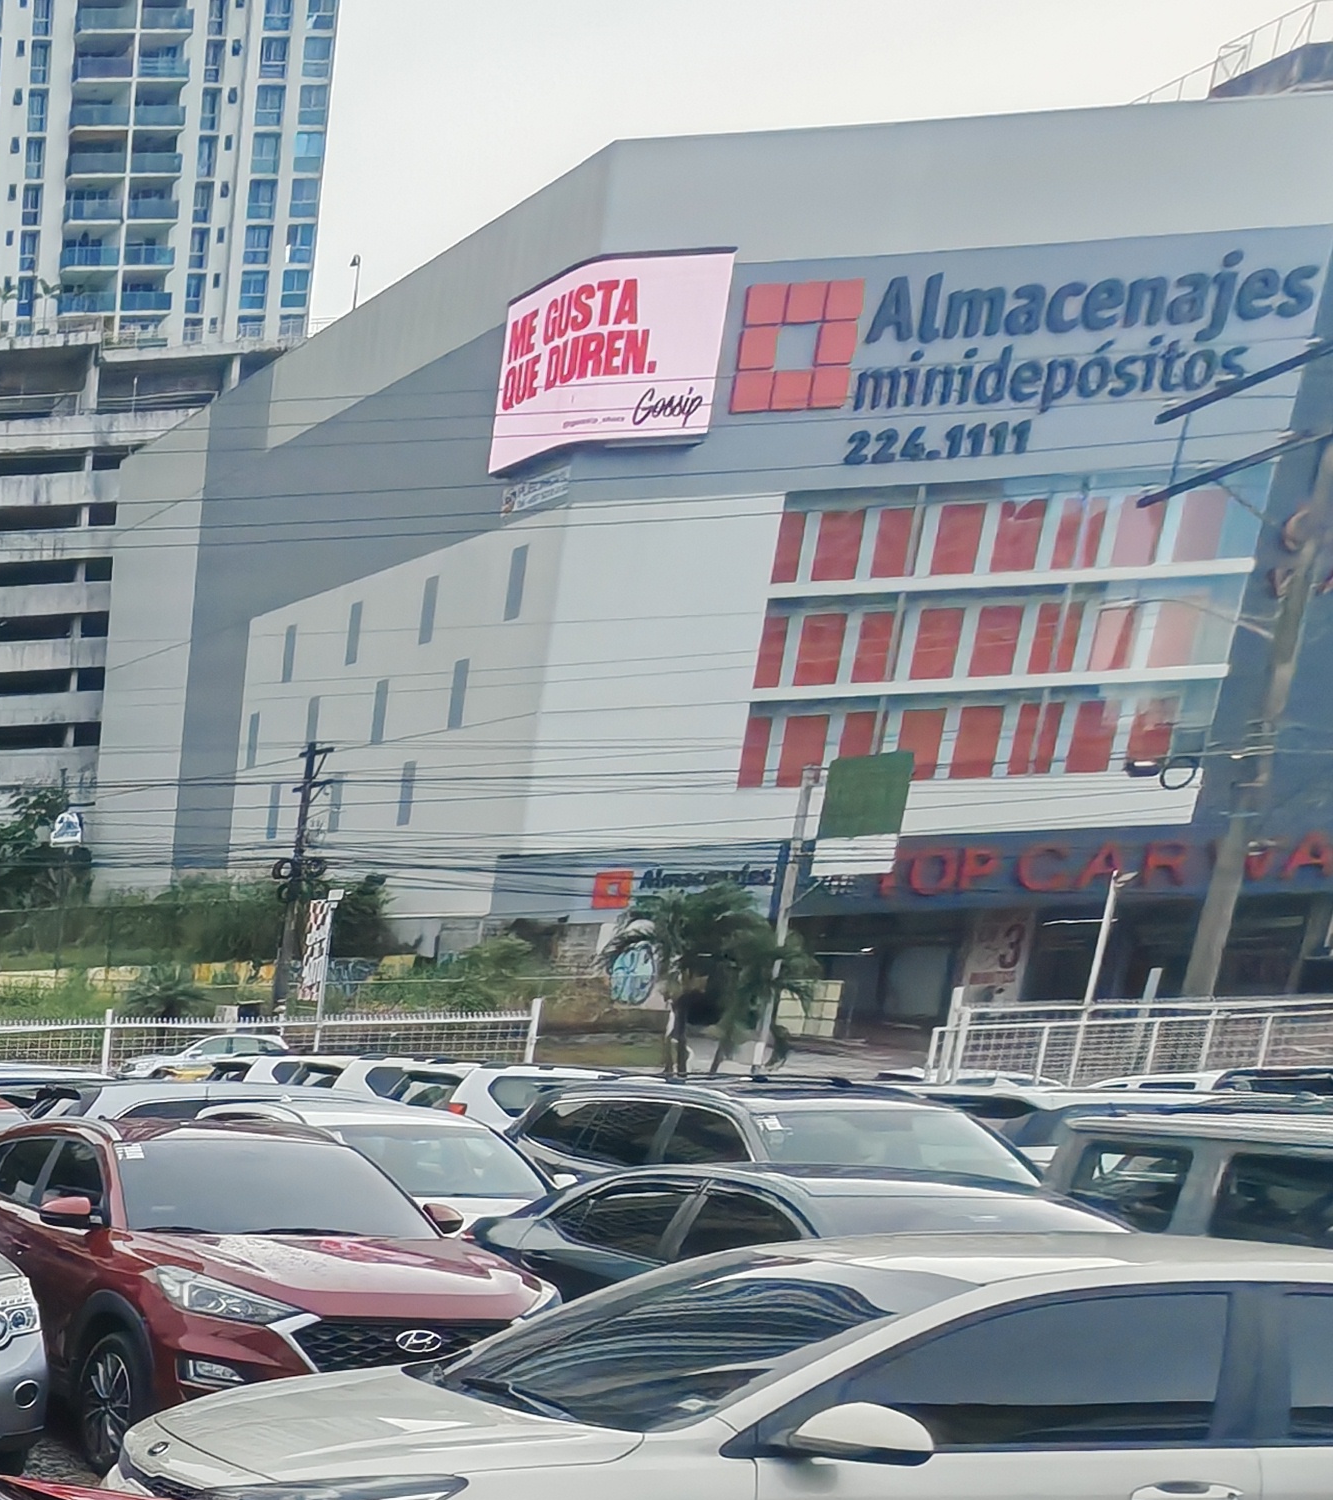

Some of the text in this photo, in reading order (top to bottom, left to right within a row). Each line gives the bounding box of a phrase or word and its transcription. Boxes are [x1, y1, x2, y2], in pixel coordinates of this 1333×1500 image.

[507, 278, 638, 365] ME GUSTA
[864, 249, 1321, 345] Almacenajes
[502, 328, 657, 411] QUE DUREN.
[632, 386, 703, 428] Gossip
[852, 334, 1250, 414] minidepósitos
[843, 418, 1032, 465] 224.1111
[1015, 838, 1188, 893] CAR
